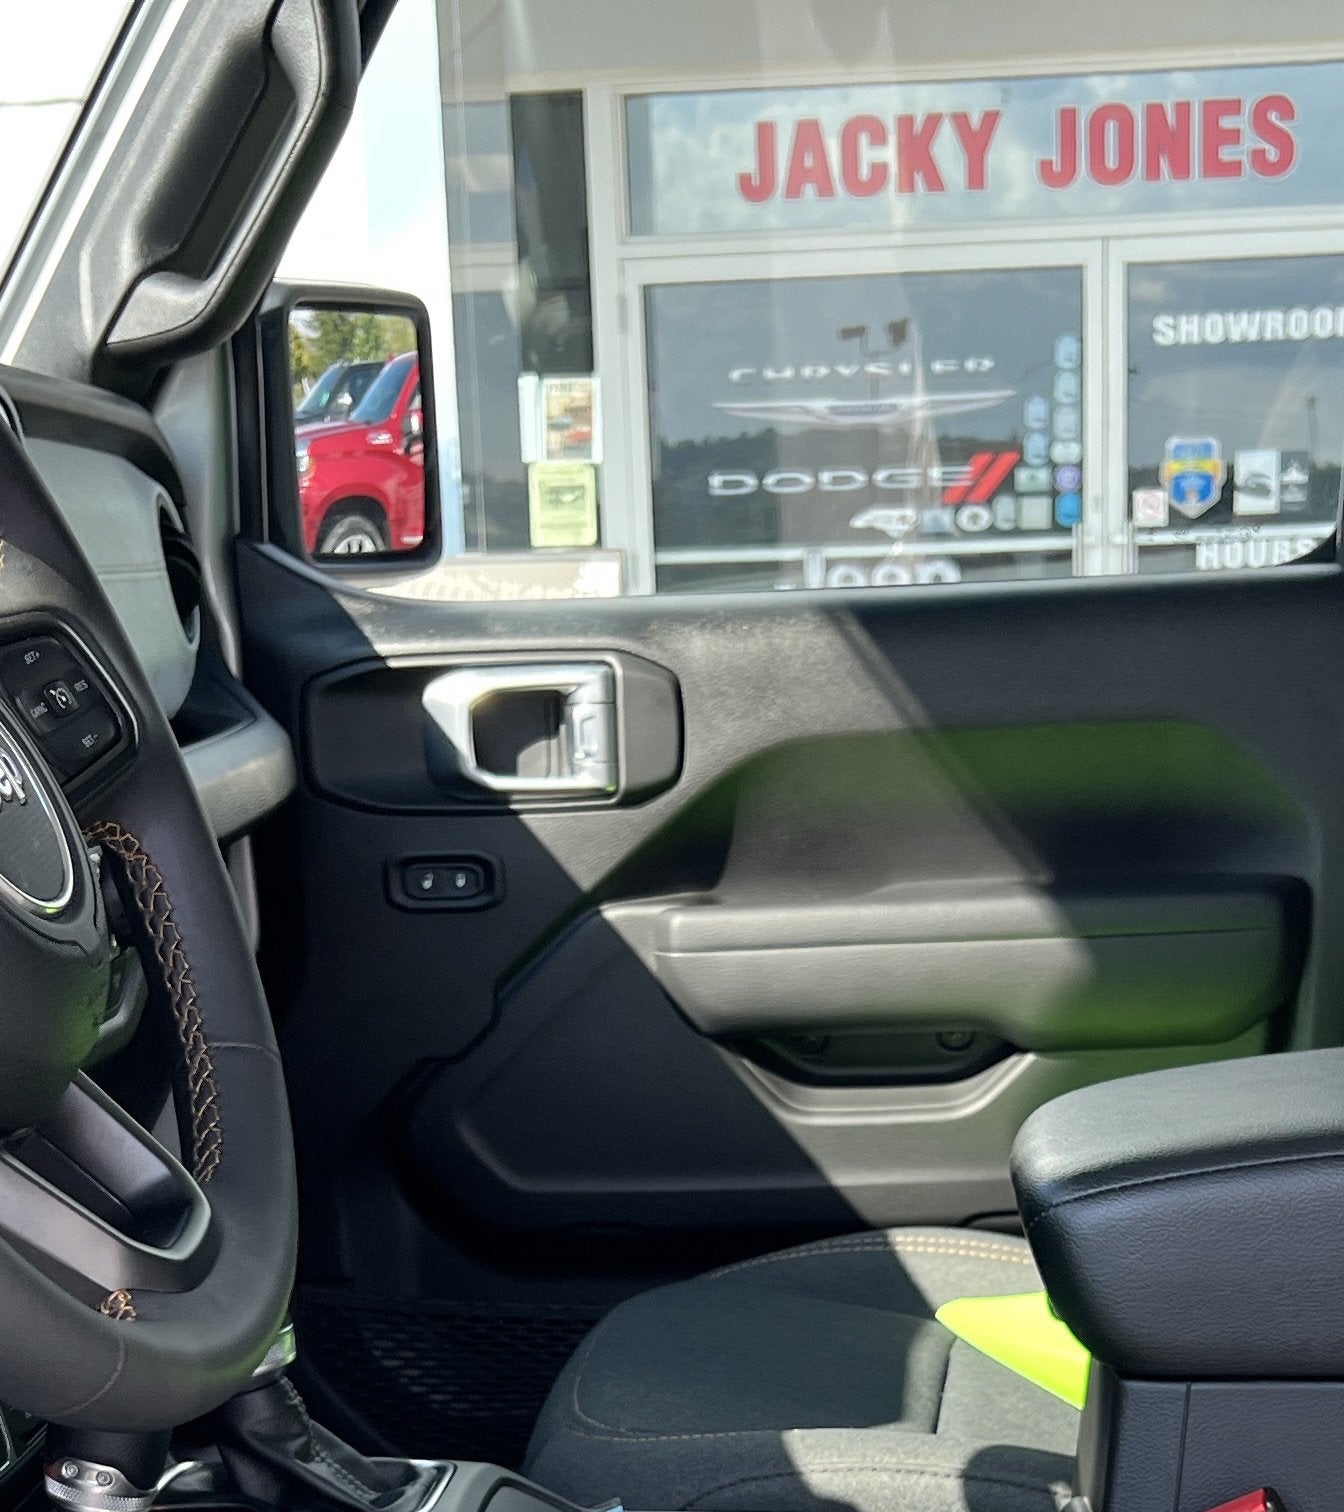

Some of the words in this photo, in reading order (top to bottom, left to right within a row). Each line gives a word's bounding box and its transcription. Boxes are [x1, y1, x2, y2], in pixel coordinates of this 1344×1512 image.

[737, 108, 1002, 203] JACKY
[1039, 94, 1297, 189] JONES
[707, 464, 976, 497] DODGE
